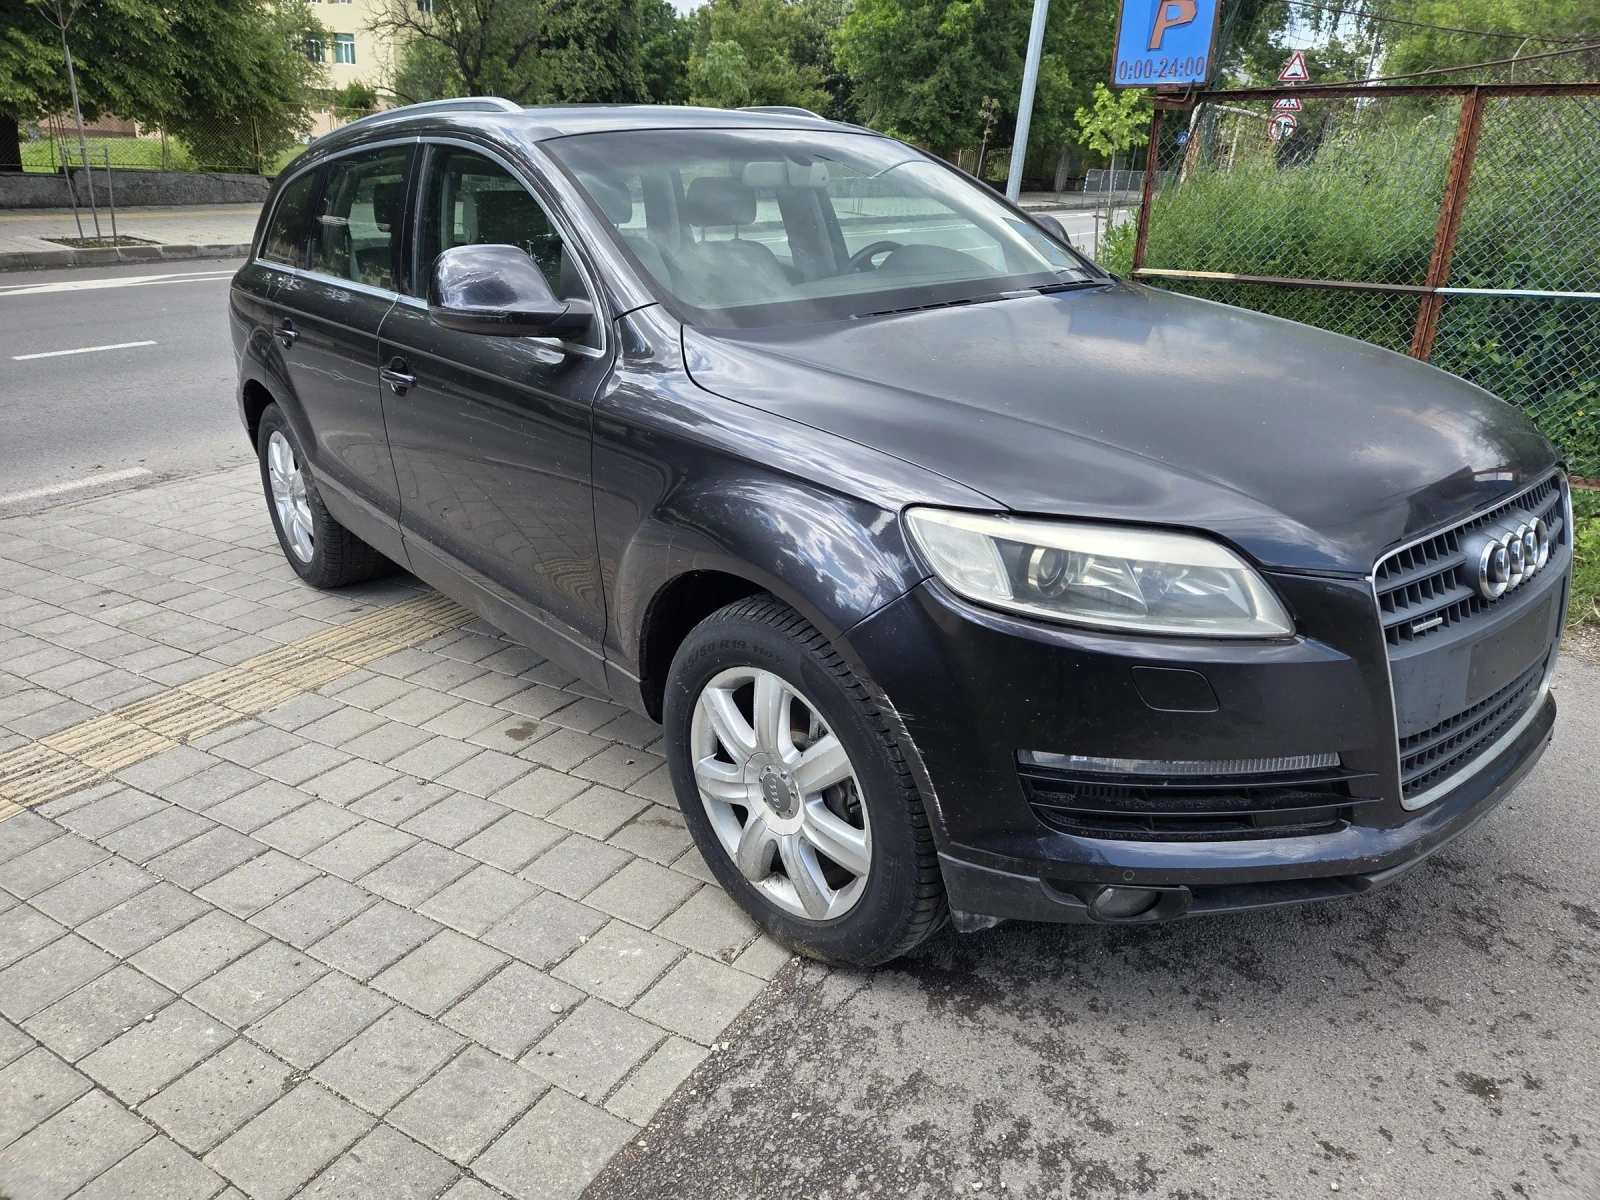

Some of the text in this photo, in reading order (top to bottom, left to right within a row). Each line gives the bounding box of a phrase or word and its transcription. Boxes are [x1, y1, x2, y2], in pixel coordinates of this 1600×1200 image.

[1147, 0, 1198, 51] P
[1119, 56, 1205, 80] 0:00-24:00
[719, 639, 746, 650] R19
